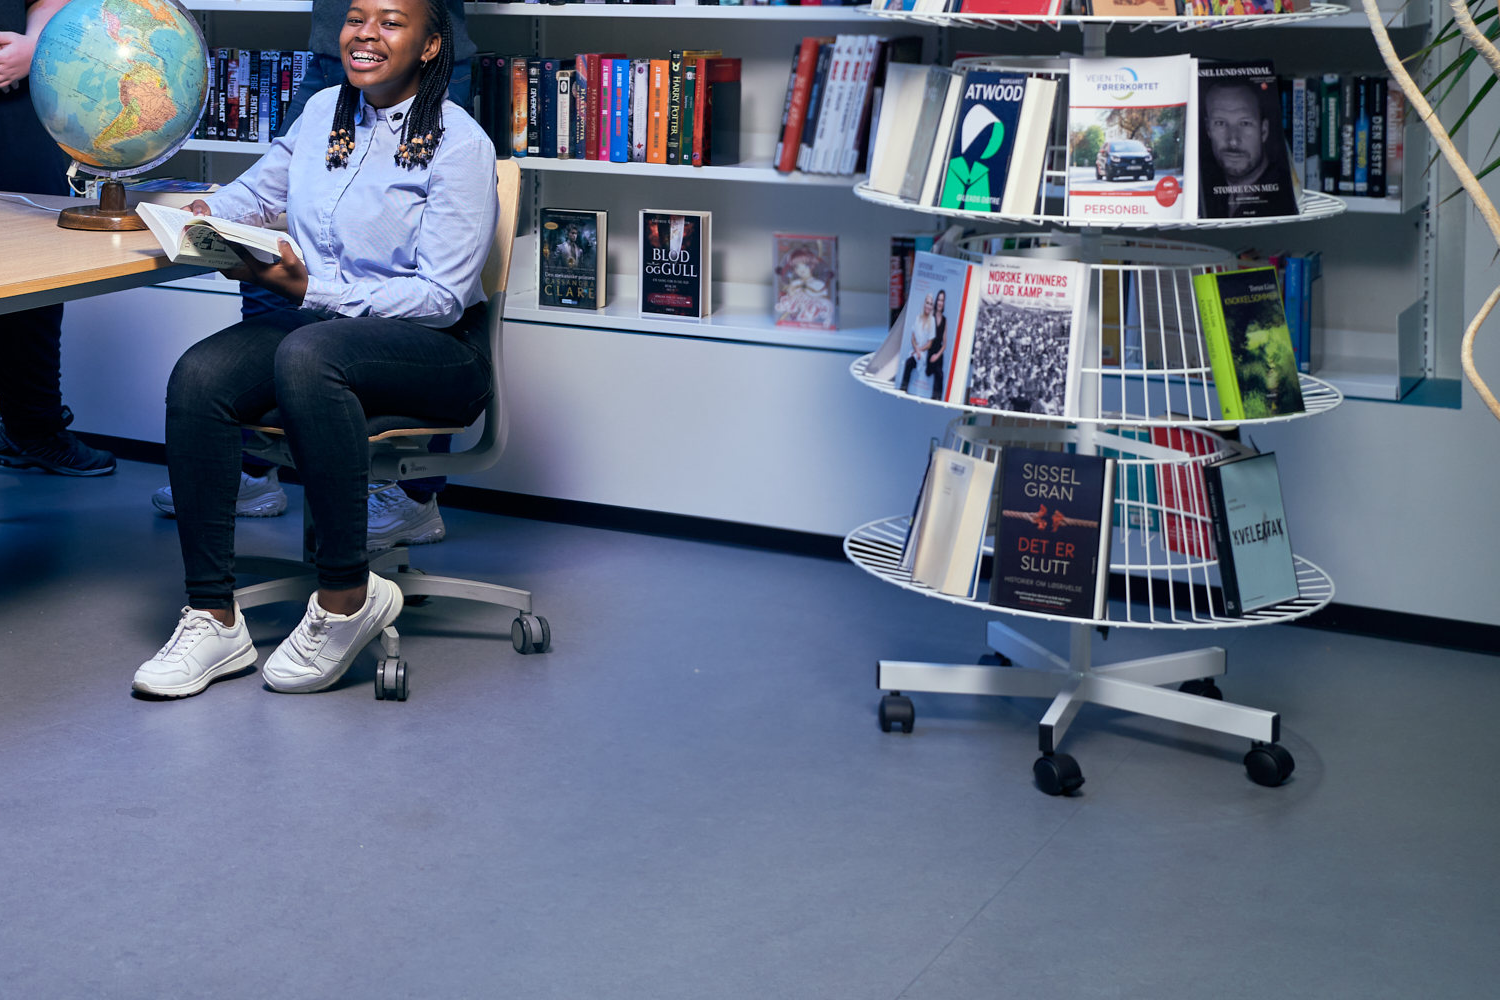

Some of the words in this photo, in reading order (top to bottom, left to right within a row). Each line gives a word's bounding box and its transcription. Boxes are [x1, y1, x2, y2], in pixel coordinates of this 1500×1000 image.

[294, 54, 302, 81] CHRIS
[1219, 68, 1236, 76] LUND
[1237, 67, 1271, 76] SVINDAL
[1086, 74, 1112, 83] VEIEN
[1114, 73, 1127, 82] TIL
[1097, 82, 1159, 91] FØRERKORTET
[260, 77, 269, 97] TEIGE
[672, 76, 681, 104] HARRY
[965, 83, 1024, 101] ATWOOD
[250, 95, 258, 117] JENTA
[270, 86, 278, 130] LIVBÅTEN
[671, 105, 679, 135] POTTER
[1372, 116, 1382, 140] DEN
[1371, 142, 1382, 176] SISTE
[1213, 184, 1243, 194] STØRRE
[1244, 184, 1260, 193] ENN
[1261, 183, 1279, 192] MEG
[1084, 204, 1149, 215] PERSONBIL
[653, 248, 690, 263] BLOD
[645, 265, 661, 275] OG
[661, 263, 698, 278] GULL
[545, 278, 595, 287] CASSANDRA
[989, 271, 1021, 284] NORSKE
[1024, 272, 1068, 288] KVINNERS
[544, 284, 595, 299] CLARE
[987, 283, 1000, 296] LIV
[1003, 284, 1015, 296] OG
[1017, 285, 1043, 298] KAMP
[1224, 292, 1278, 305] KNOKKELSOMMER
[1022, 463, 1081, 486] SISSEL
[1024, 482, 1074, 502] GRAN
[1018, 537, 1049, 554] DET
[1055, 542, 1075, 558] ER
[1020, 555, 1070, 576] SLUTT
[1004, 576, 1034, 586] HISTORIER
[1047, 581, 1082, 593] LØSRIVELSE
